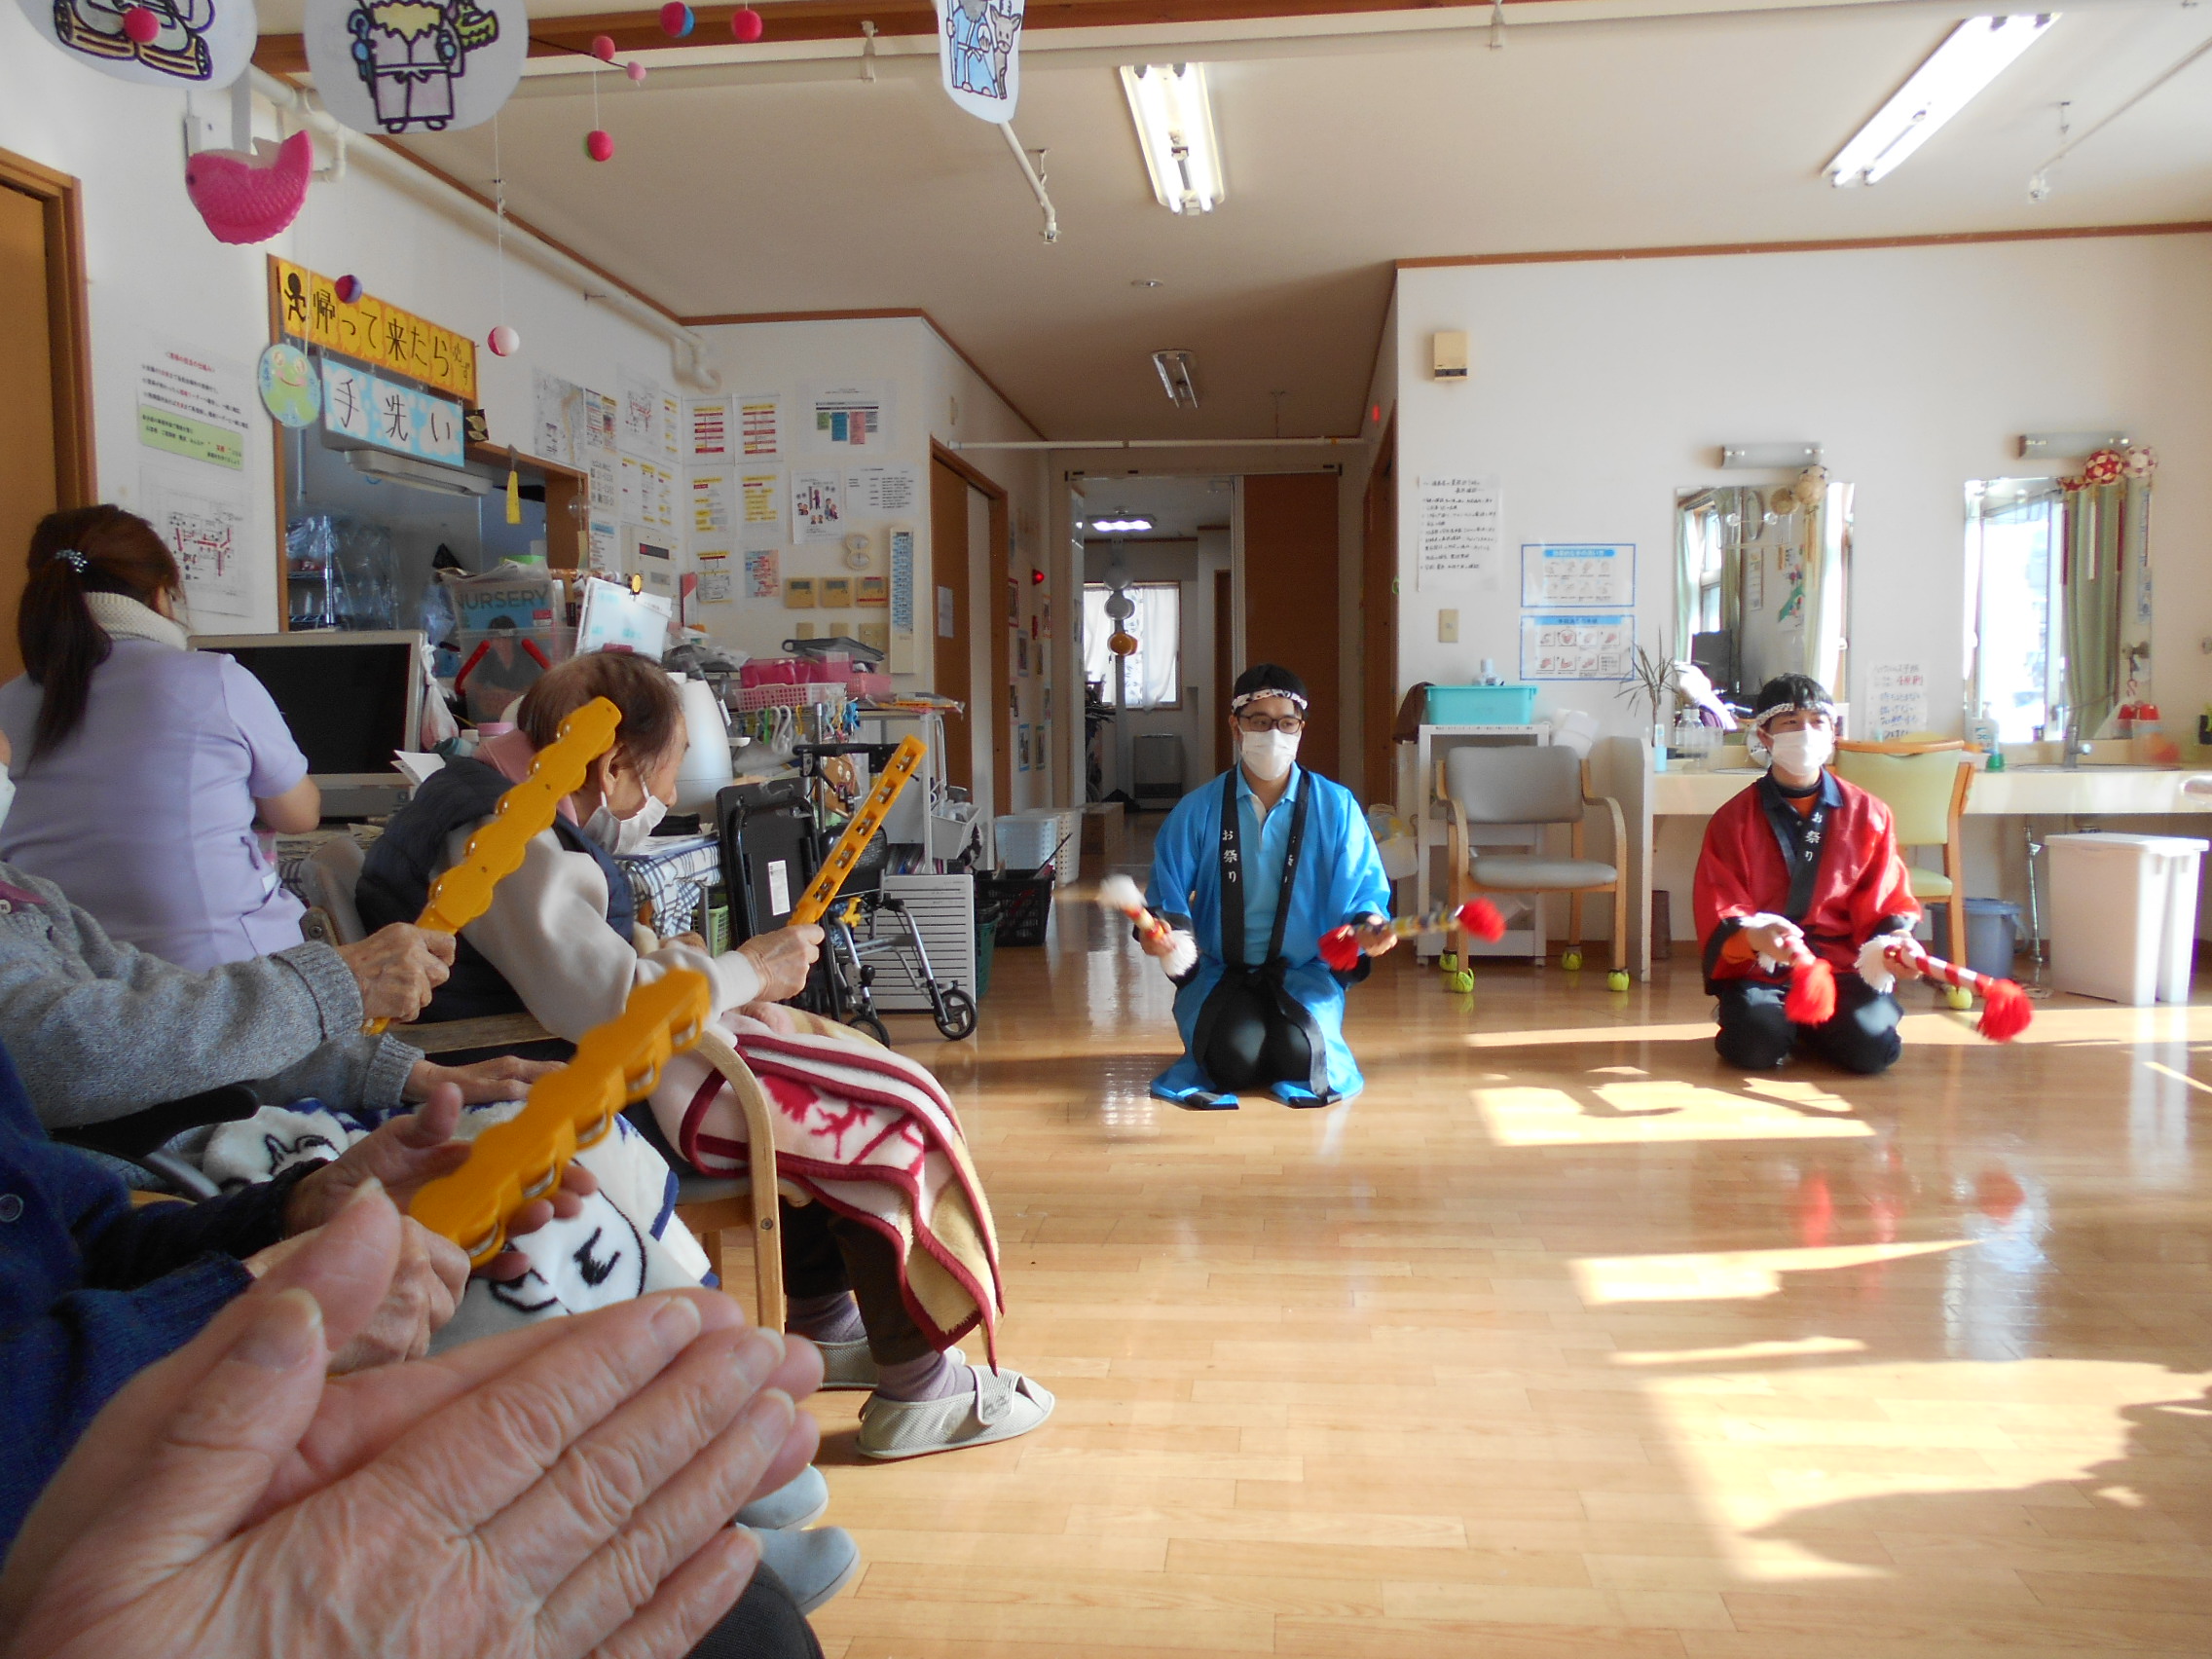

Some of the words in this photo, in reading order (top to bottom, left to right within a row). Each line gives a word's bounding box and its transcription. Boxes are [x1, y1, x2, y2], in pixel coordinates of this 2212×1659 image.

[334, 378, 451, 441] 手洗い
[1222, 830, 1238, 883] お祭り
[1805, 811, 1824, 862] お祭り
